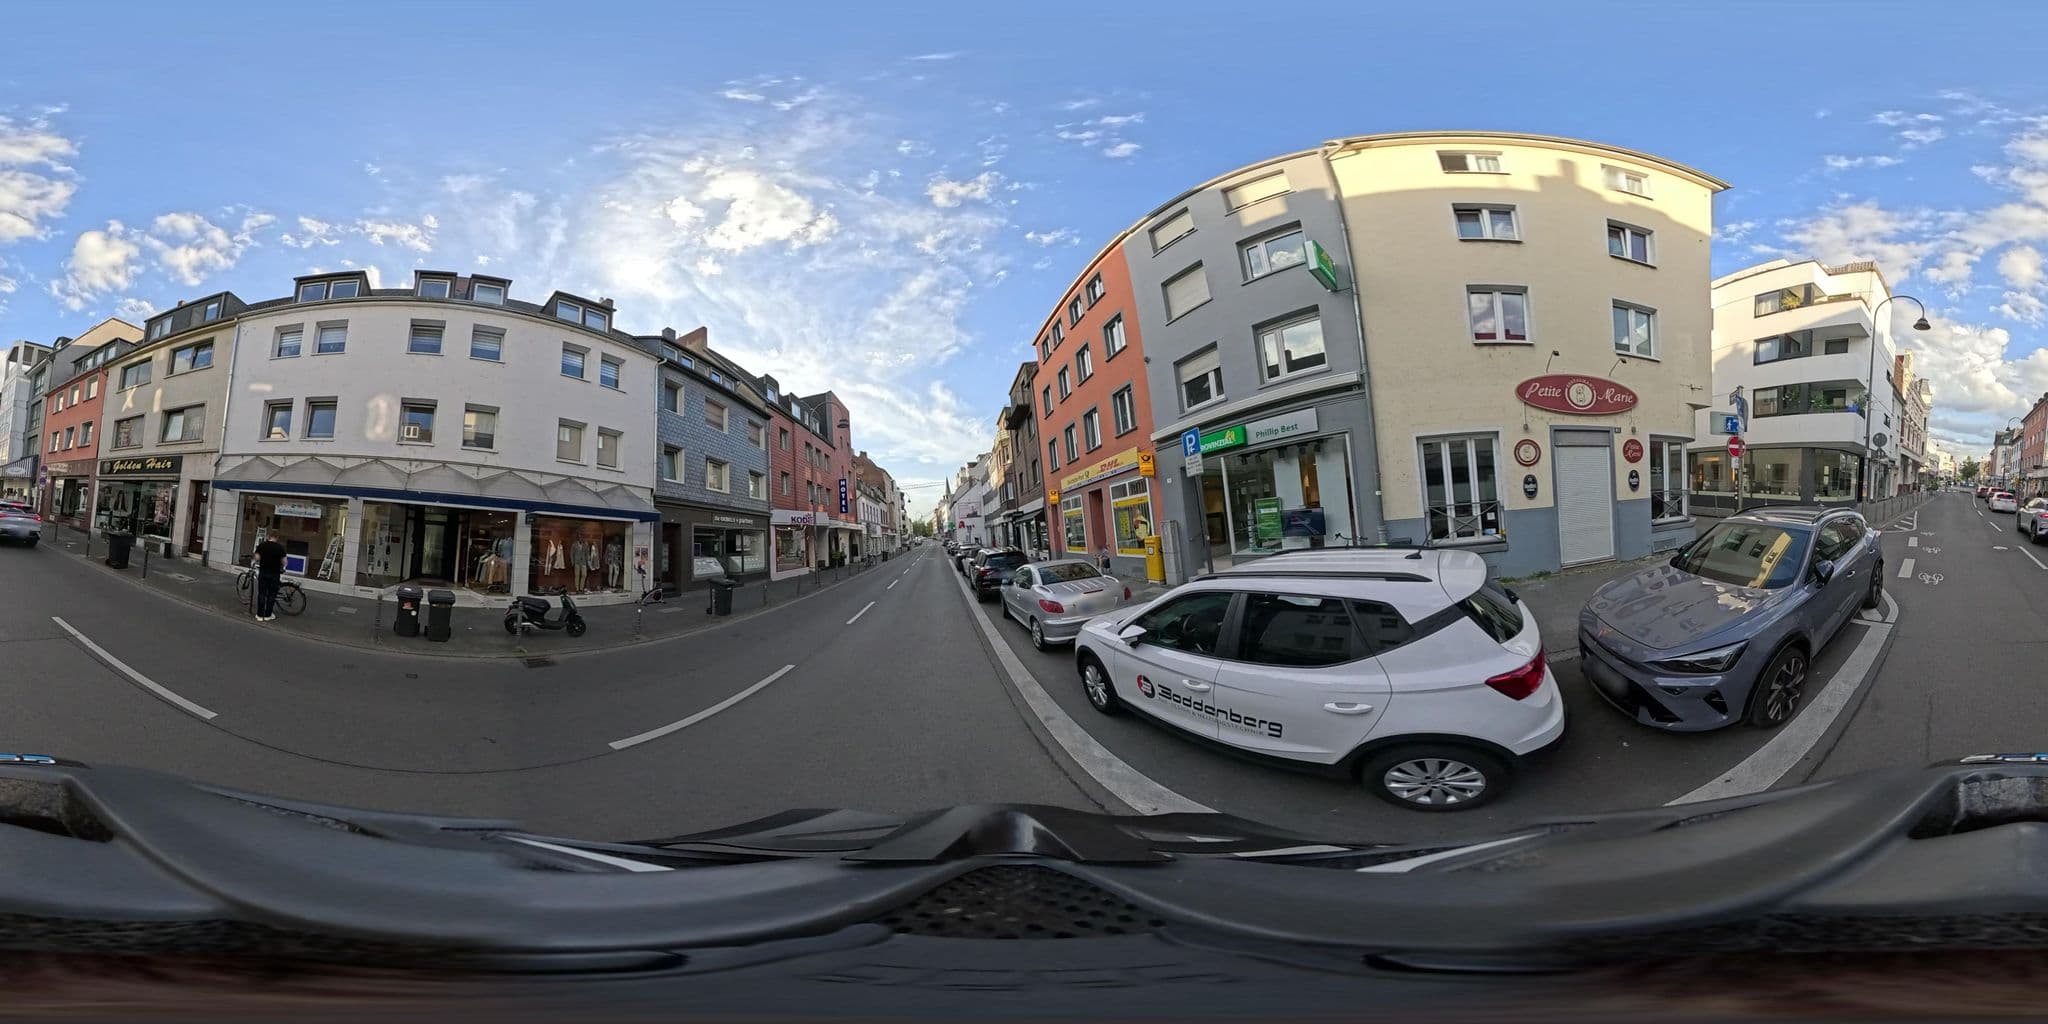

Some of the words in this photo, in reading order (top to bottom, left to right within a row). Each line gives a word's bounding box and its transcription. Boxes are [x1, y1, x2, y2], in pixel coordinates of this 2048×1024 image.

[1525, 383, 1561, 398] Petite
[1598, 388, 1633, 403] Marie
[1256, 428, 1280, 439] Phillip
[1281, 424, 1299, 432] Best
[113, 460, 142, 473] Golden
[145, 457, 172, 469] Hair
[1100, 459, 1120, 471] DHL
[1158, 684, 1283, 738] Boddenberg
